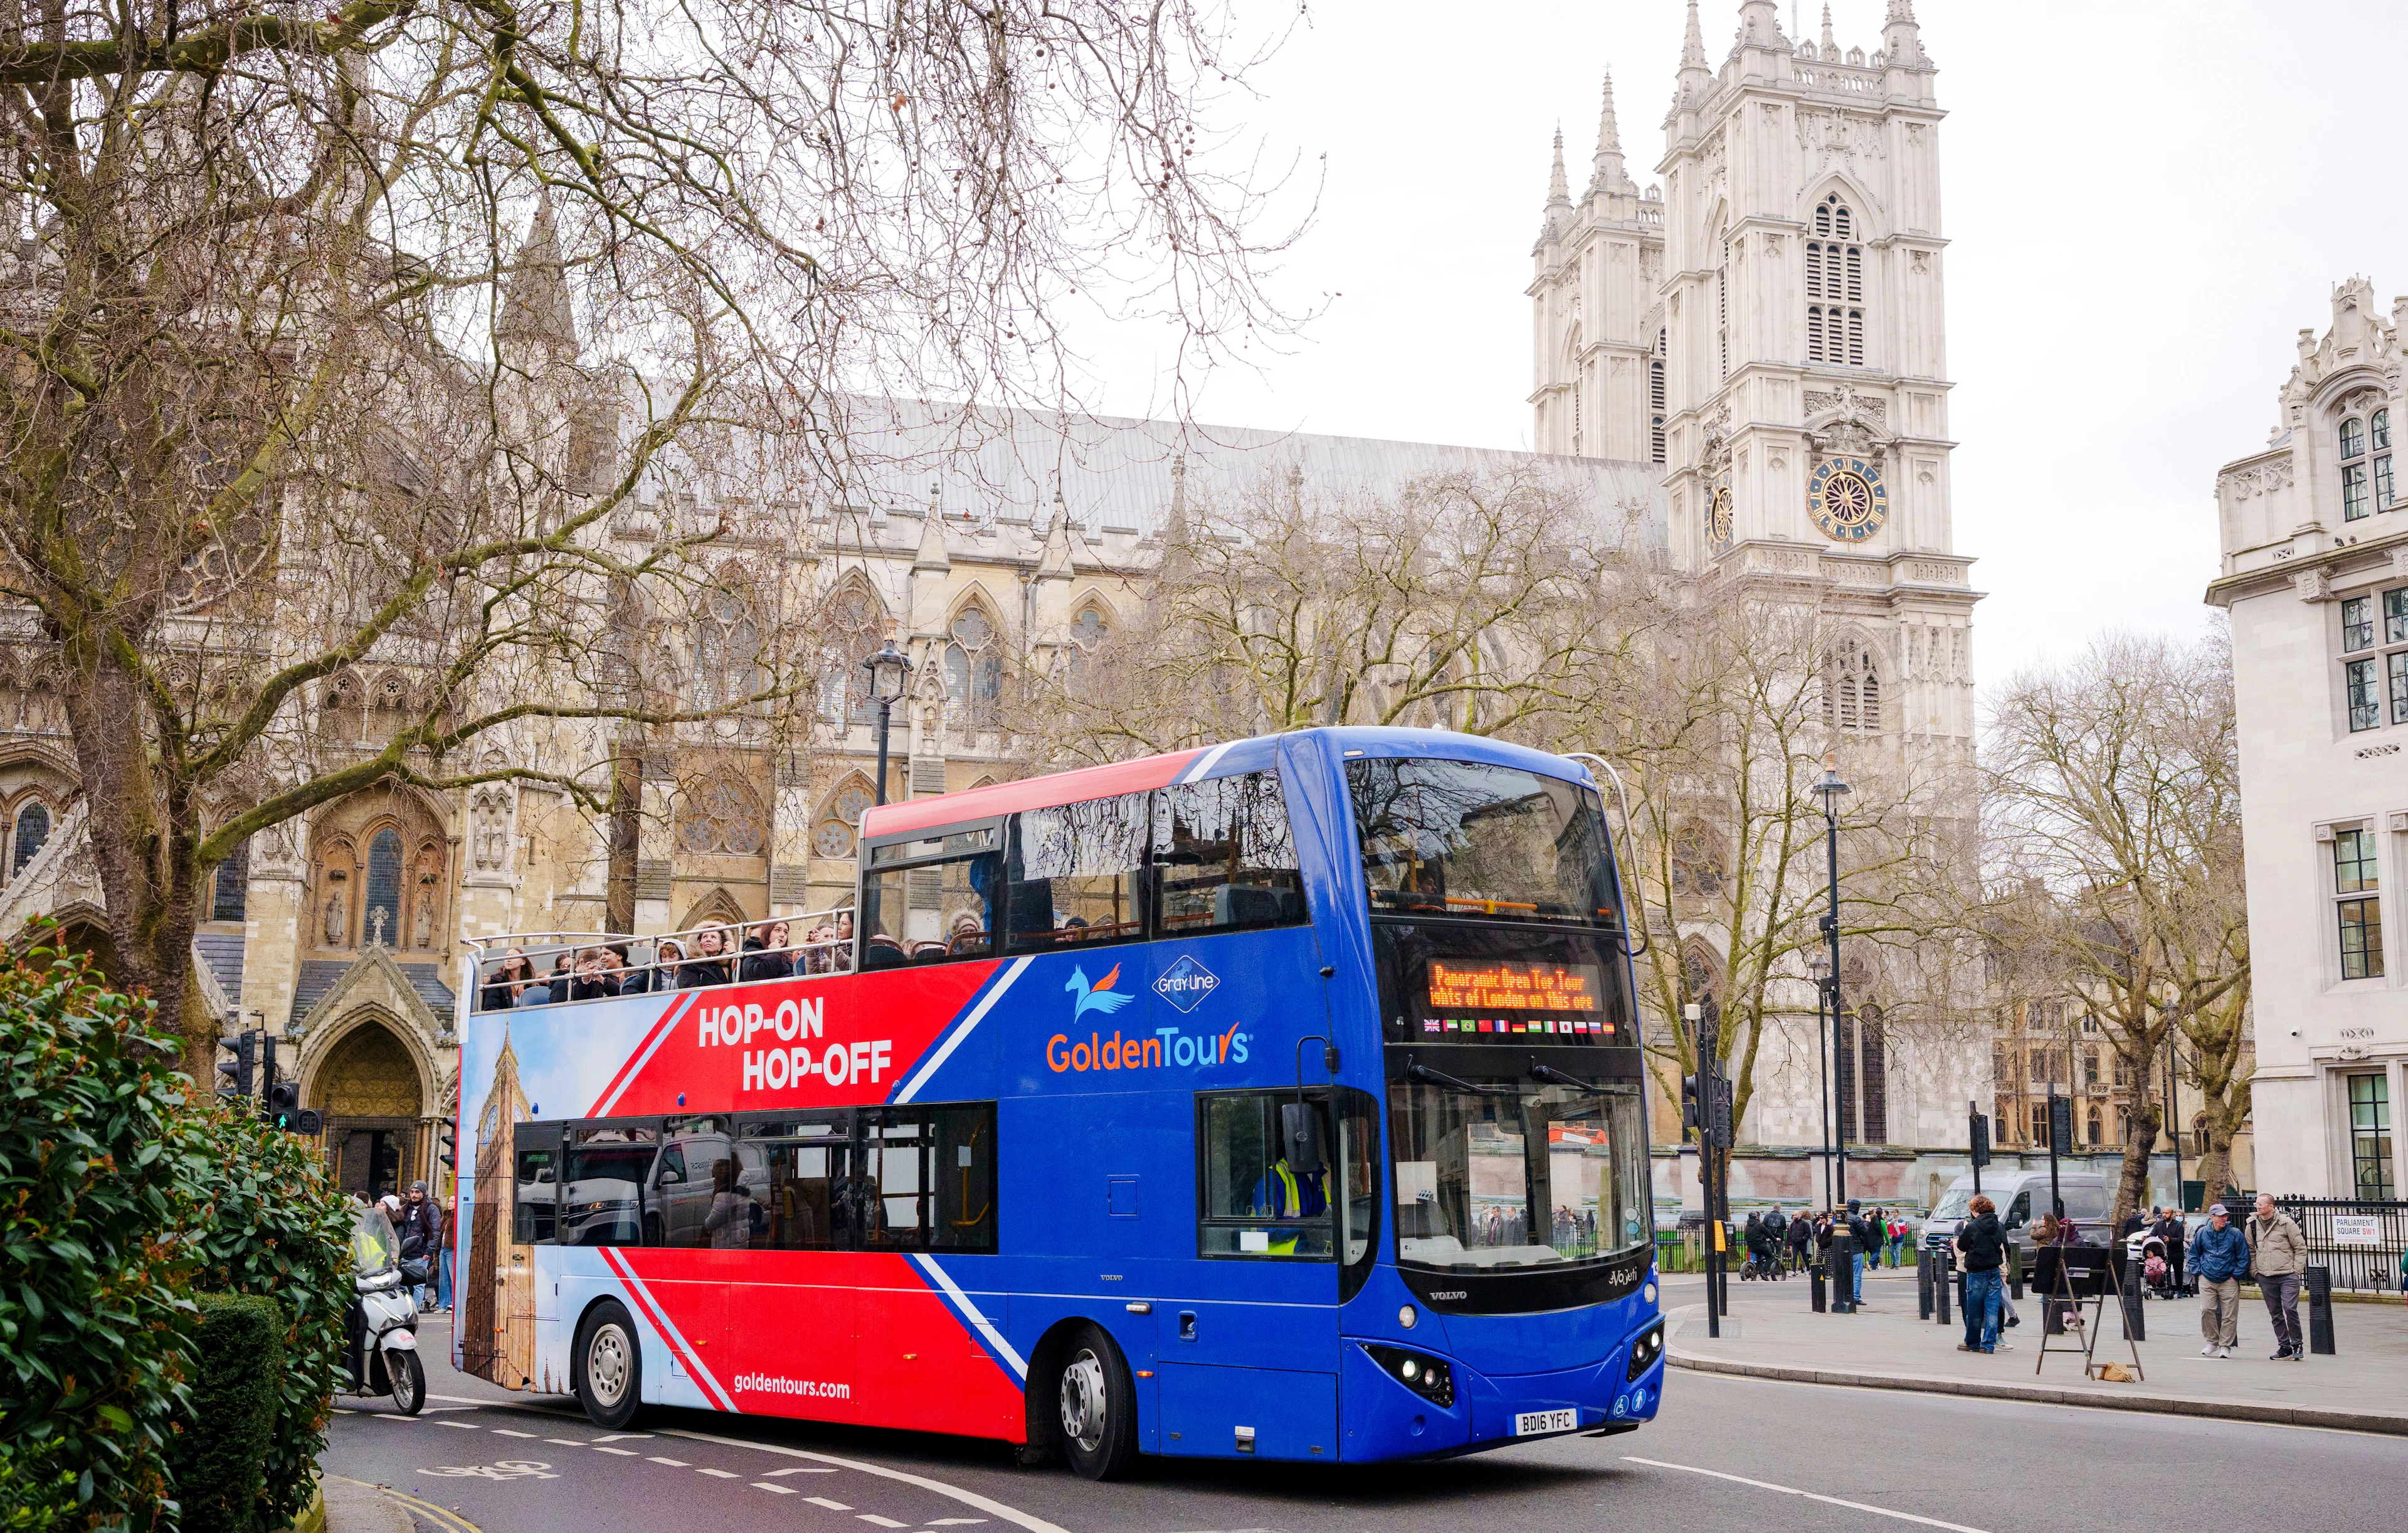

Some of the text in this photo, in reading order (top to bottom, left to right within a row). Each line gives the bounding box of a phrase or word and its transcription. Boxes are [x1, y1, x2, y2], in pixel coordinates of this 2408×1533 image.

[1159, 974, 1213, 992] Gray Line
[1434, 965, 1585, 990] Panoramic Open Top Tour
[1465, 989, 1479, 1005] of
[1482, 989, 1526, 1007] London
[1529, 995, 1544, 1007] on
[1546, 991, 1569, 1009] this
[699, 997, 823, 1048] HOP-ON
[743, 1039, 892, 1091] HOP-OFF
[2337, 1227, 2360, 1235] SQUARE
[1430, 1291, 1467, 1300] VOLVO
[734, 1372, 850, 1399] goldentours.com
[1523, 1412, 1570, 1432] BD16 YFC
